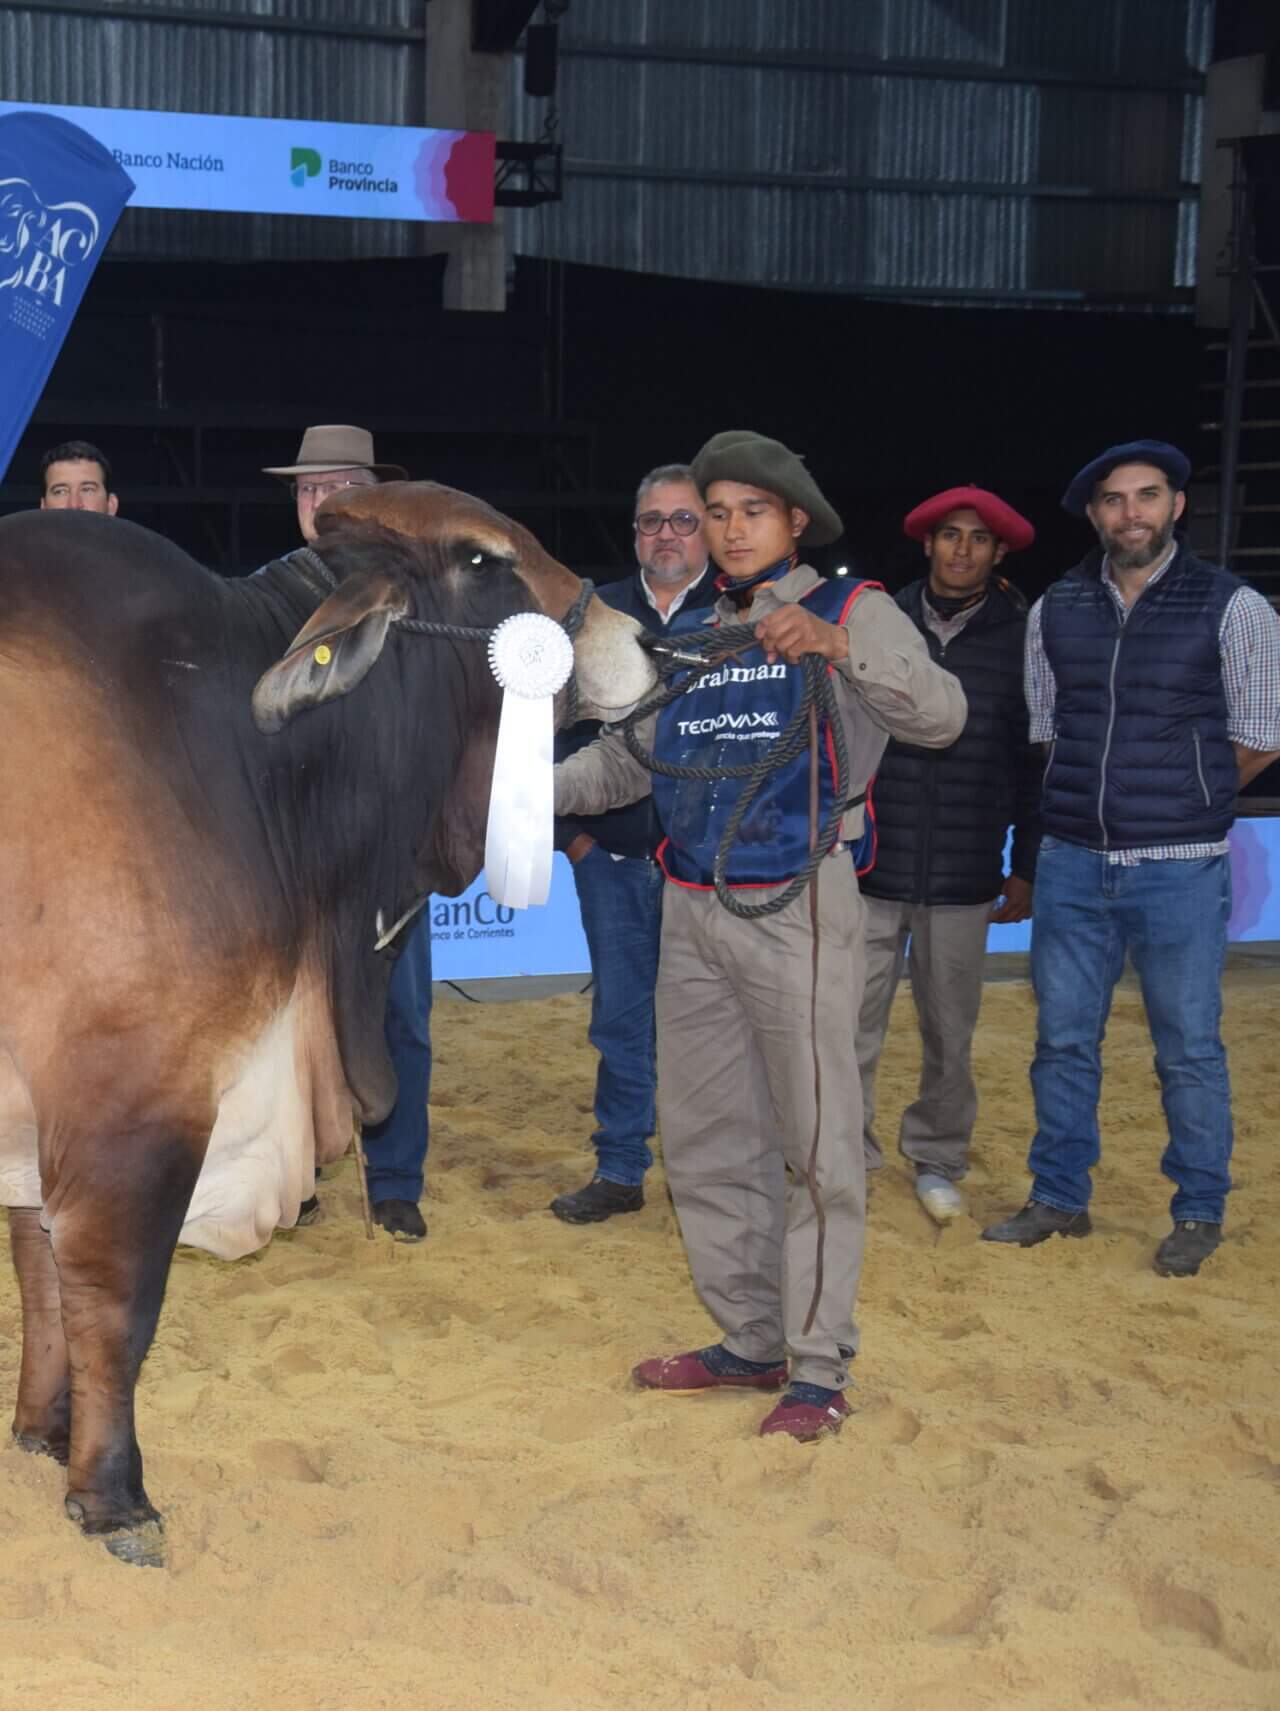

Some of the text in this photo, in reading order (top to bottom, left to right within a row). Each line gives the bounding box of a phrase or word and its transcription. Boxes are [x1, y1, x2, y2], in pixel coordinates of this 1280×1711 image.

[167, 151, 225, 172] Nación
[328, 158, 374, 175] Banco
[328, 175, 399, 193] Provincia
[35, 217, 88, 267] AC
[23, 250, 66, 307] BA
[677, 712, 772, 736] TECNOVAX
[433, 892, 515, 927] anCo
[467, 927, 515, 939] Corrientes
